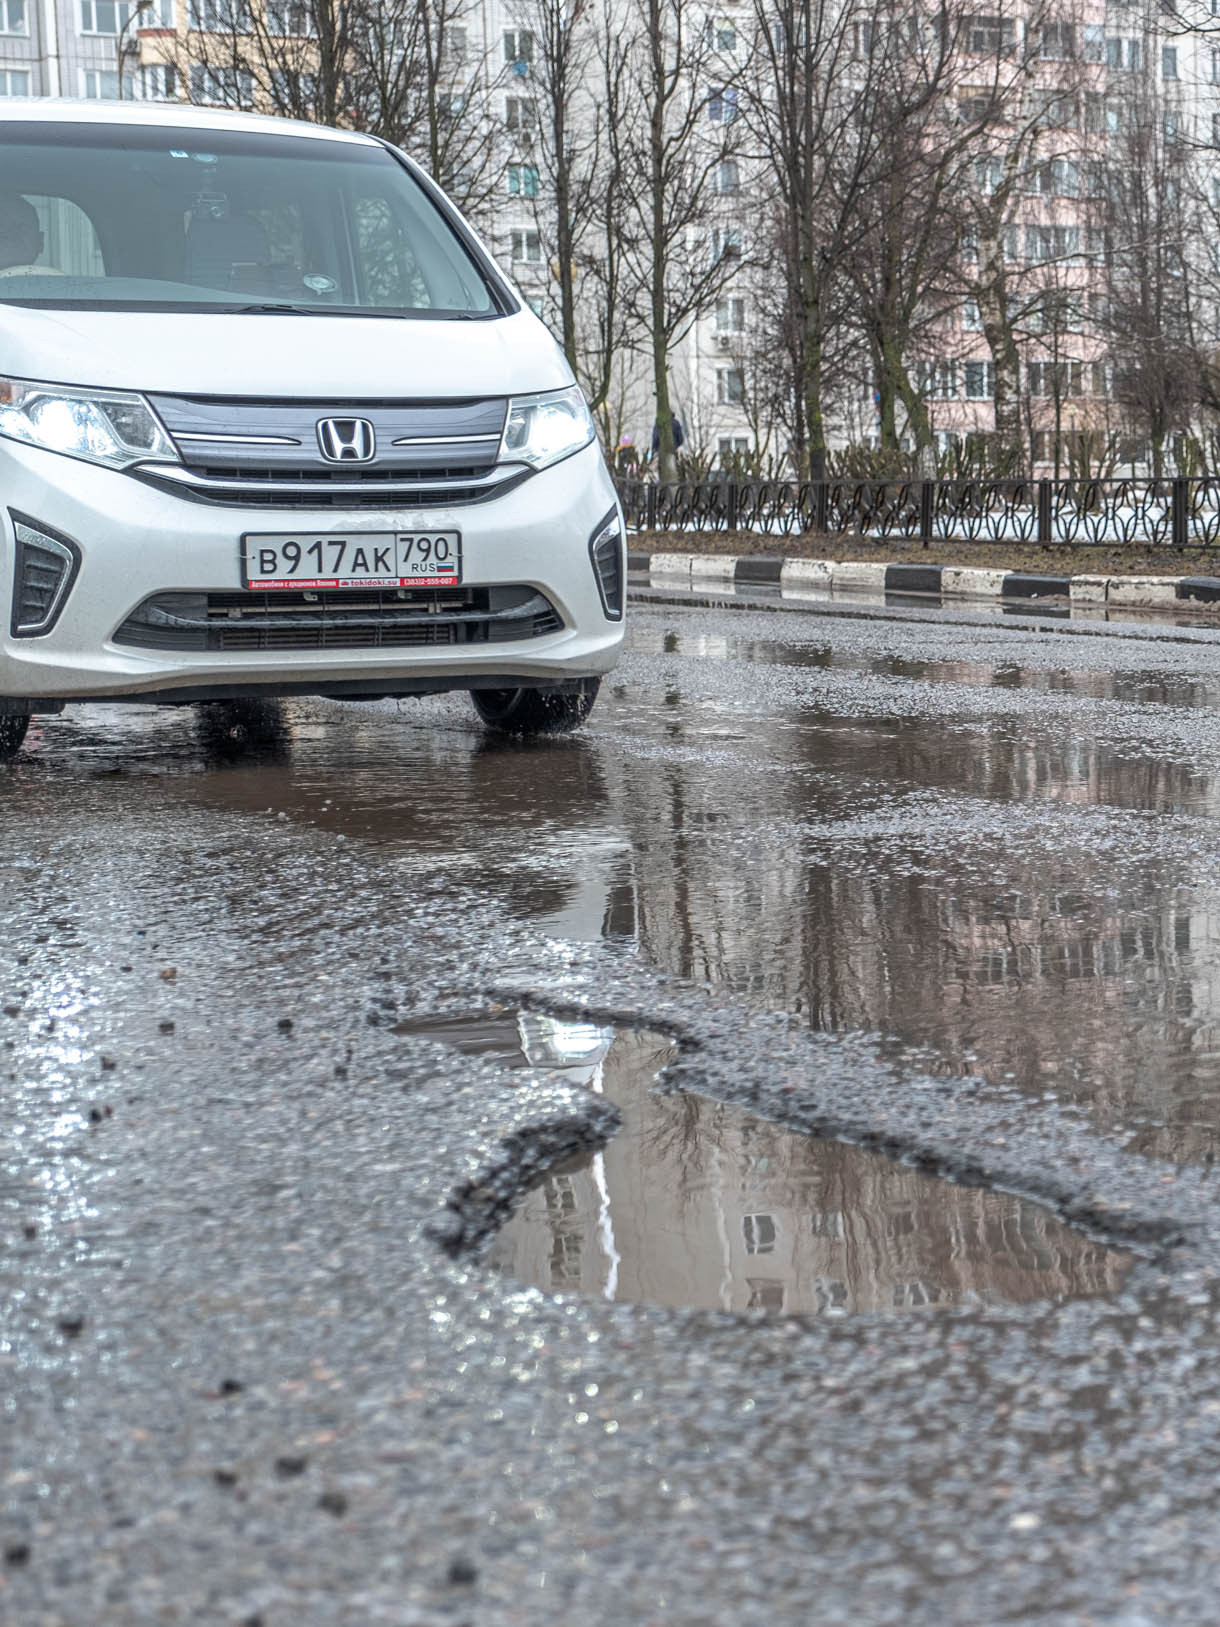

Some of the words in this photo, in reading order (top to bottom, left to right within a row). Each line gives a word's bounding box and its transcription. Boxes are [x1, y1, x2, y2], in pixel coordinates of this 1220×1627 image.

[259, 540, 391, 574] В917АК
[399, 537, 449, 562] 790
[411, 563, 436, 573] RUS
[351, 579, 397, 587] tokidoki.su
